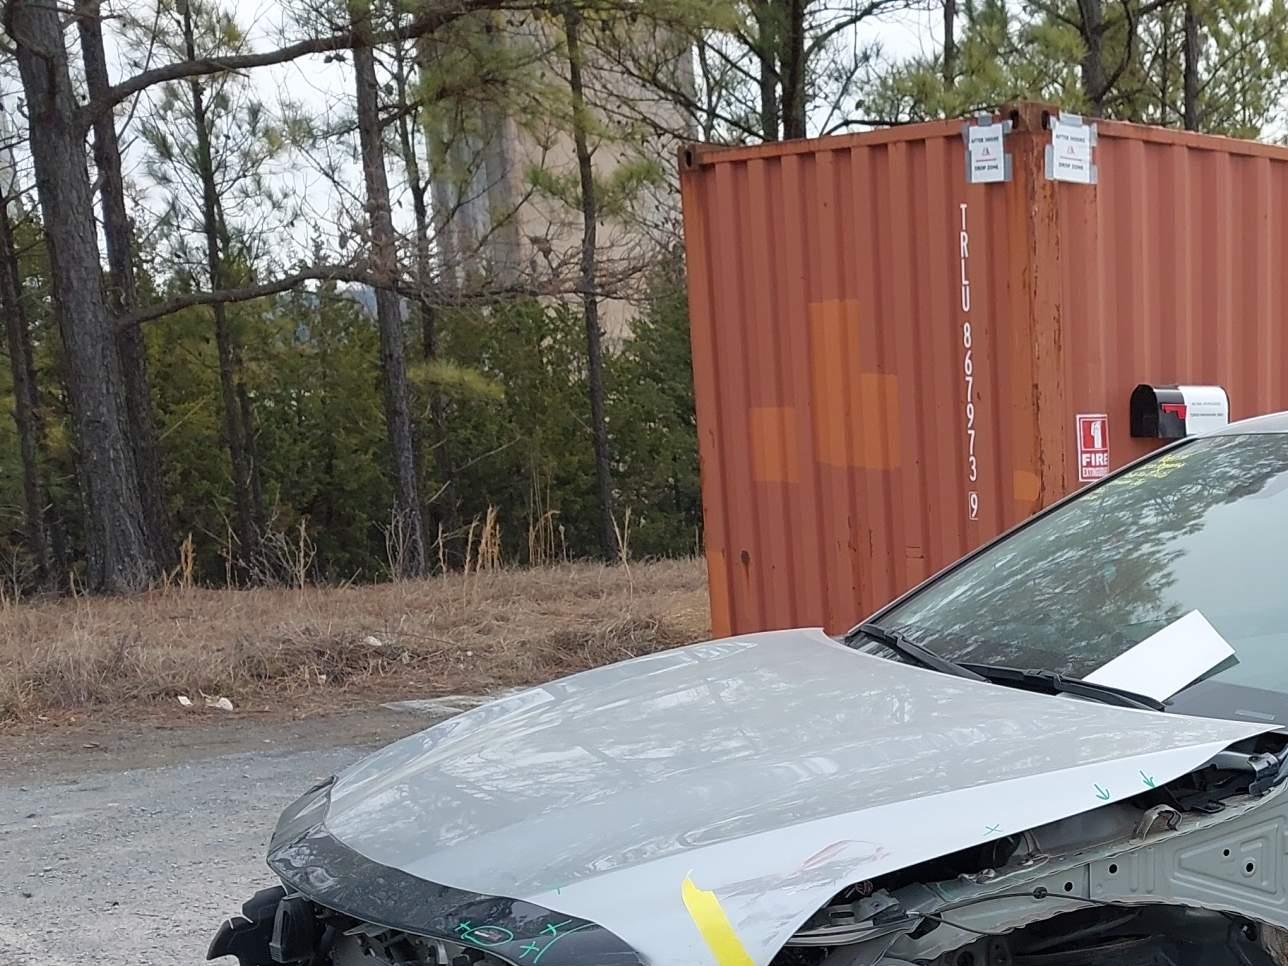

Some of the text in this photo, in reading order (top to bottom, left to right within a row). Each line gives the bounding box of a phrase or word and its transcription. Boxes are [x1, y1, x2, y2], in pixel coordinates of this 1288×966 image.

[959, 203, 978, 518] TRLU 867973 9
[1082, 453, 1109, 466] FIRE
